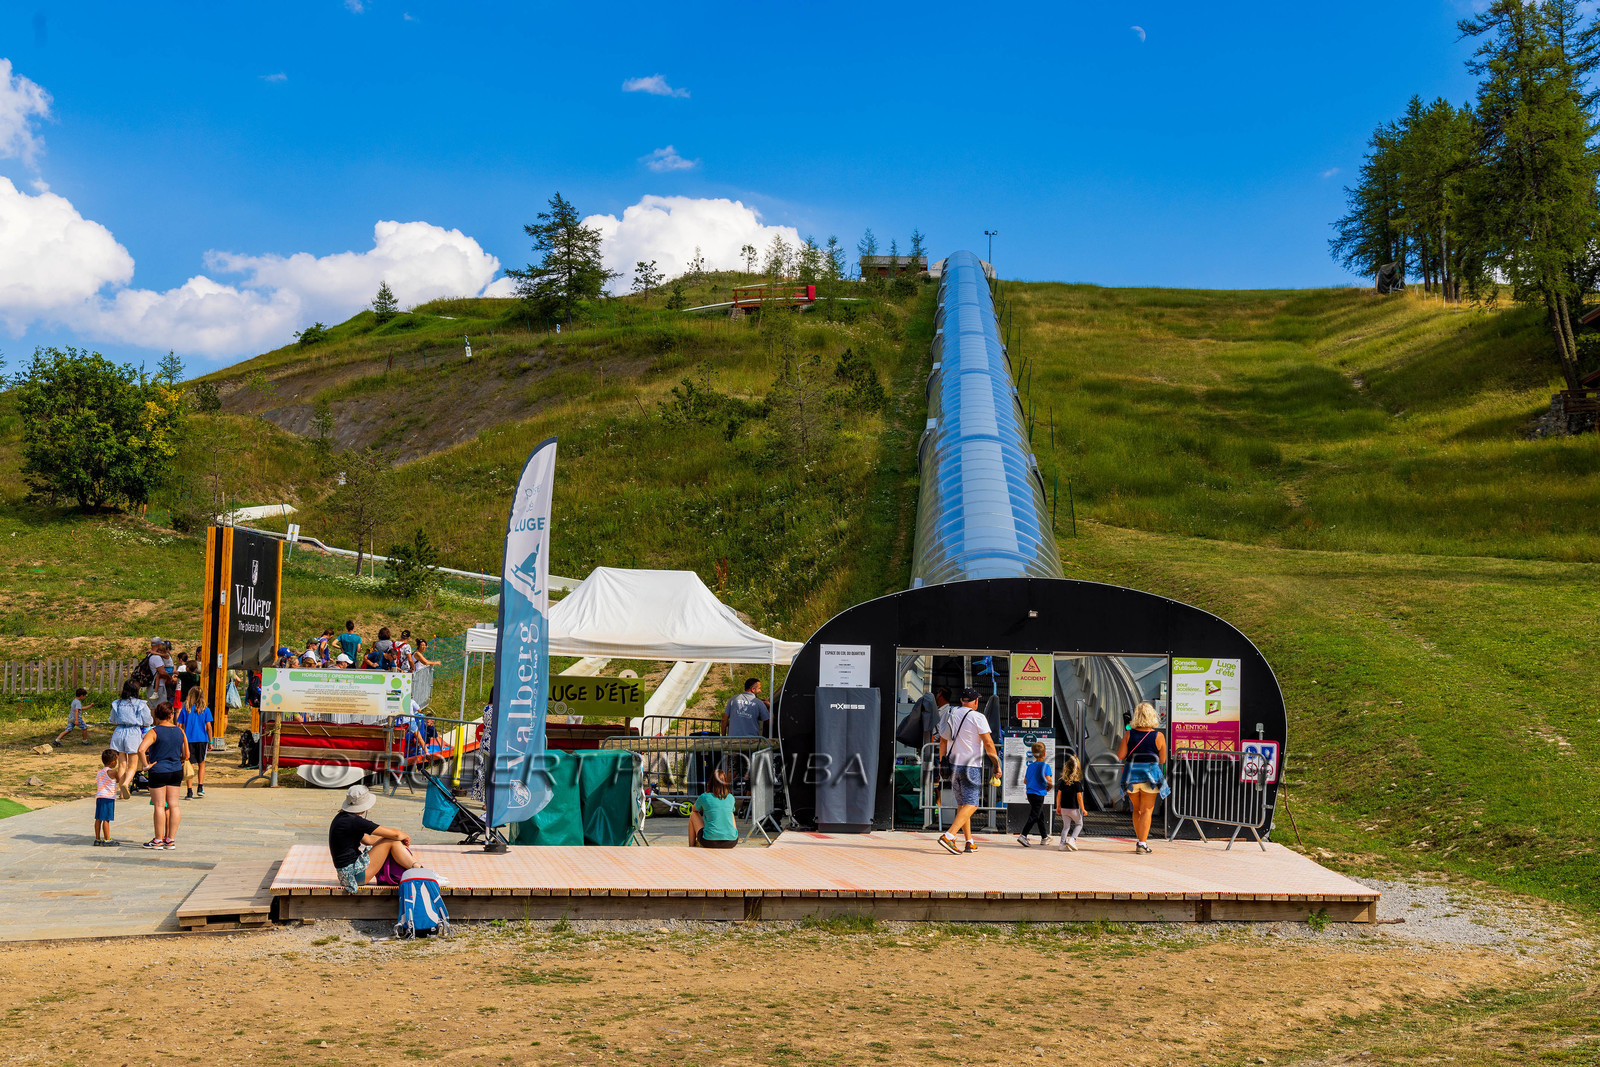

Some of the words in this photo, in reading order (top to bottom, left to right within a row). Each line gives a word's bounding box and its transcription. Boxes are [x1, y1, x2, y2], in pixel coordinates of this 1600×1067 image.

[514, 517, 546, 532] LUGE
[235, 584, 272, 629] Valberg
[245, 621, 255, 633] place
[255, 623, 260, 632] to
[260, 623, 264, 633] be
[1217, 660, 1236, 670] Luge
[1216, 668, 1234, 678] d'été
[506, 622, 540, 772] Valberg
[548, 684, 587, 702] UGE
[596, 682, 640, 704] D'ÉTÉ
